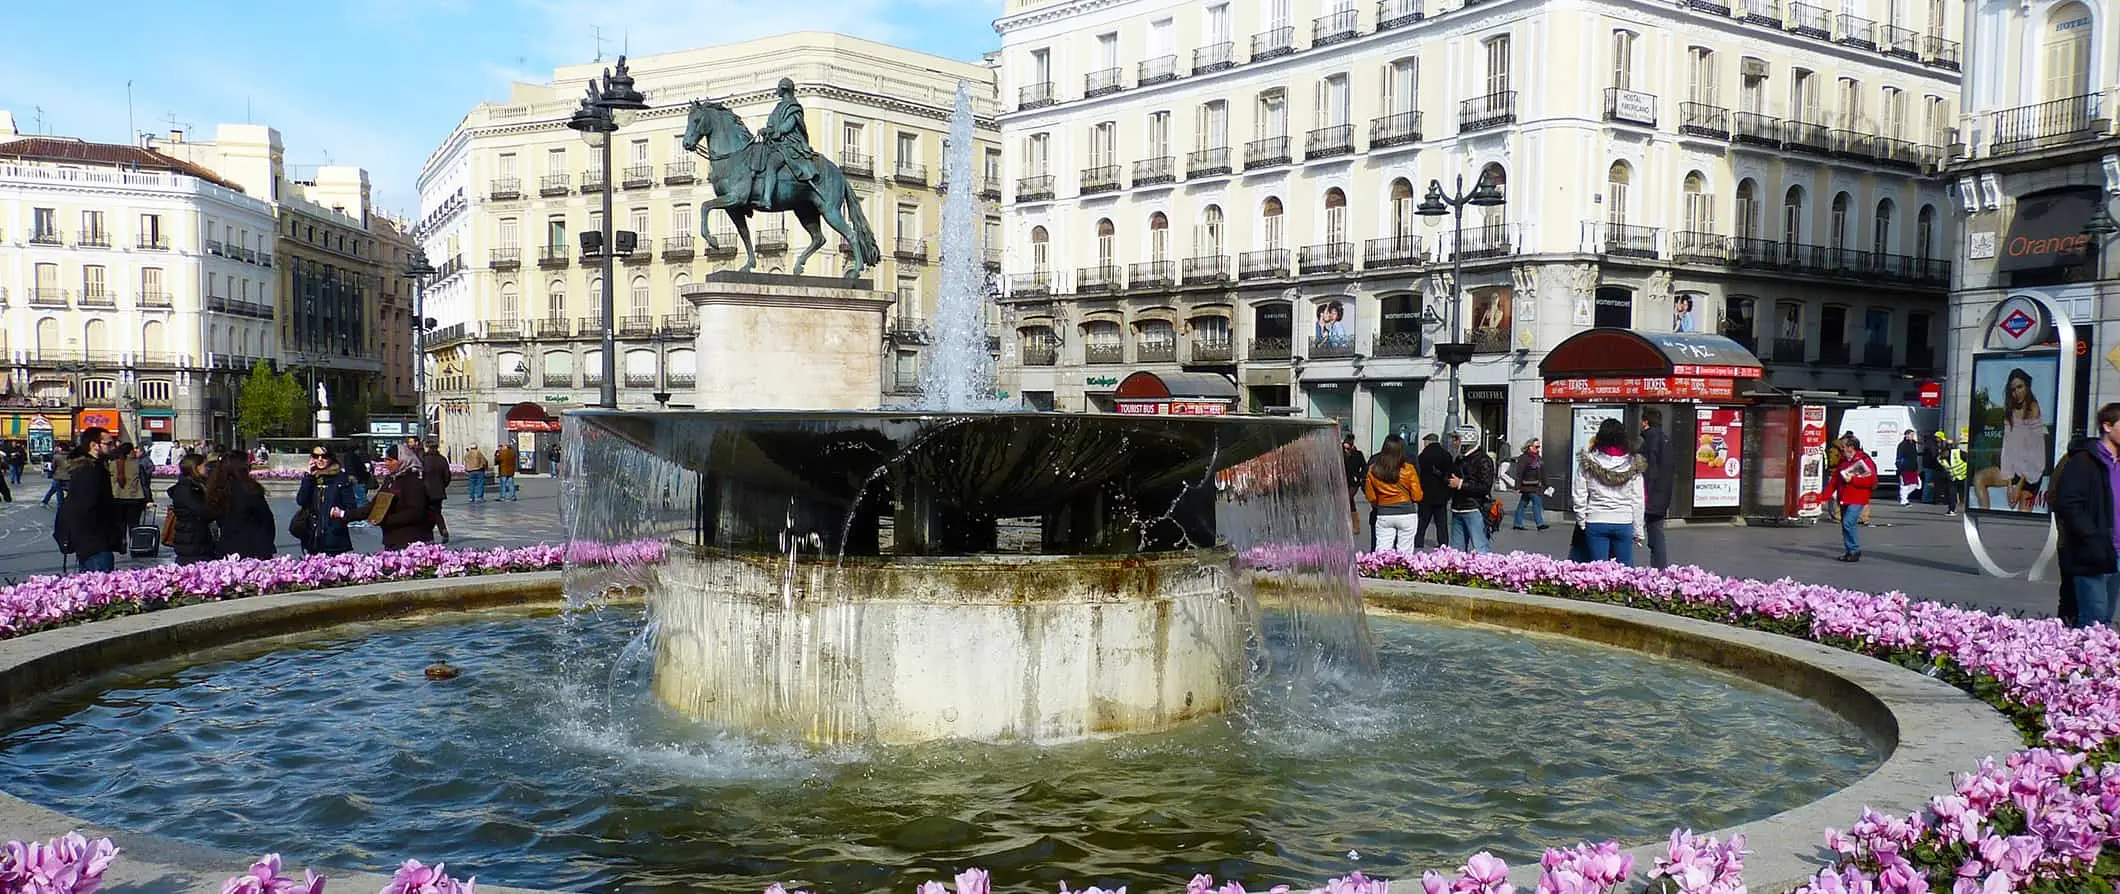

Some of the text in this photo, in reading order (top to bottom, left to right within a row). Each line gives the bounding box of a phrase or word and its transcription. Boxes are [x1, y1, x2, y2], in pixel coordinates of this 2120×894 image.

[2008, 233, 2090, 257] Orange
[1120, 403, 1142, 413] TOURIST
[1143, 403, 1155, 413] BUS
